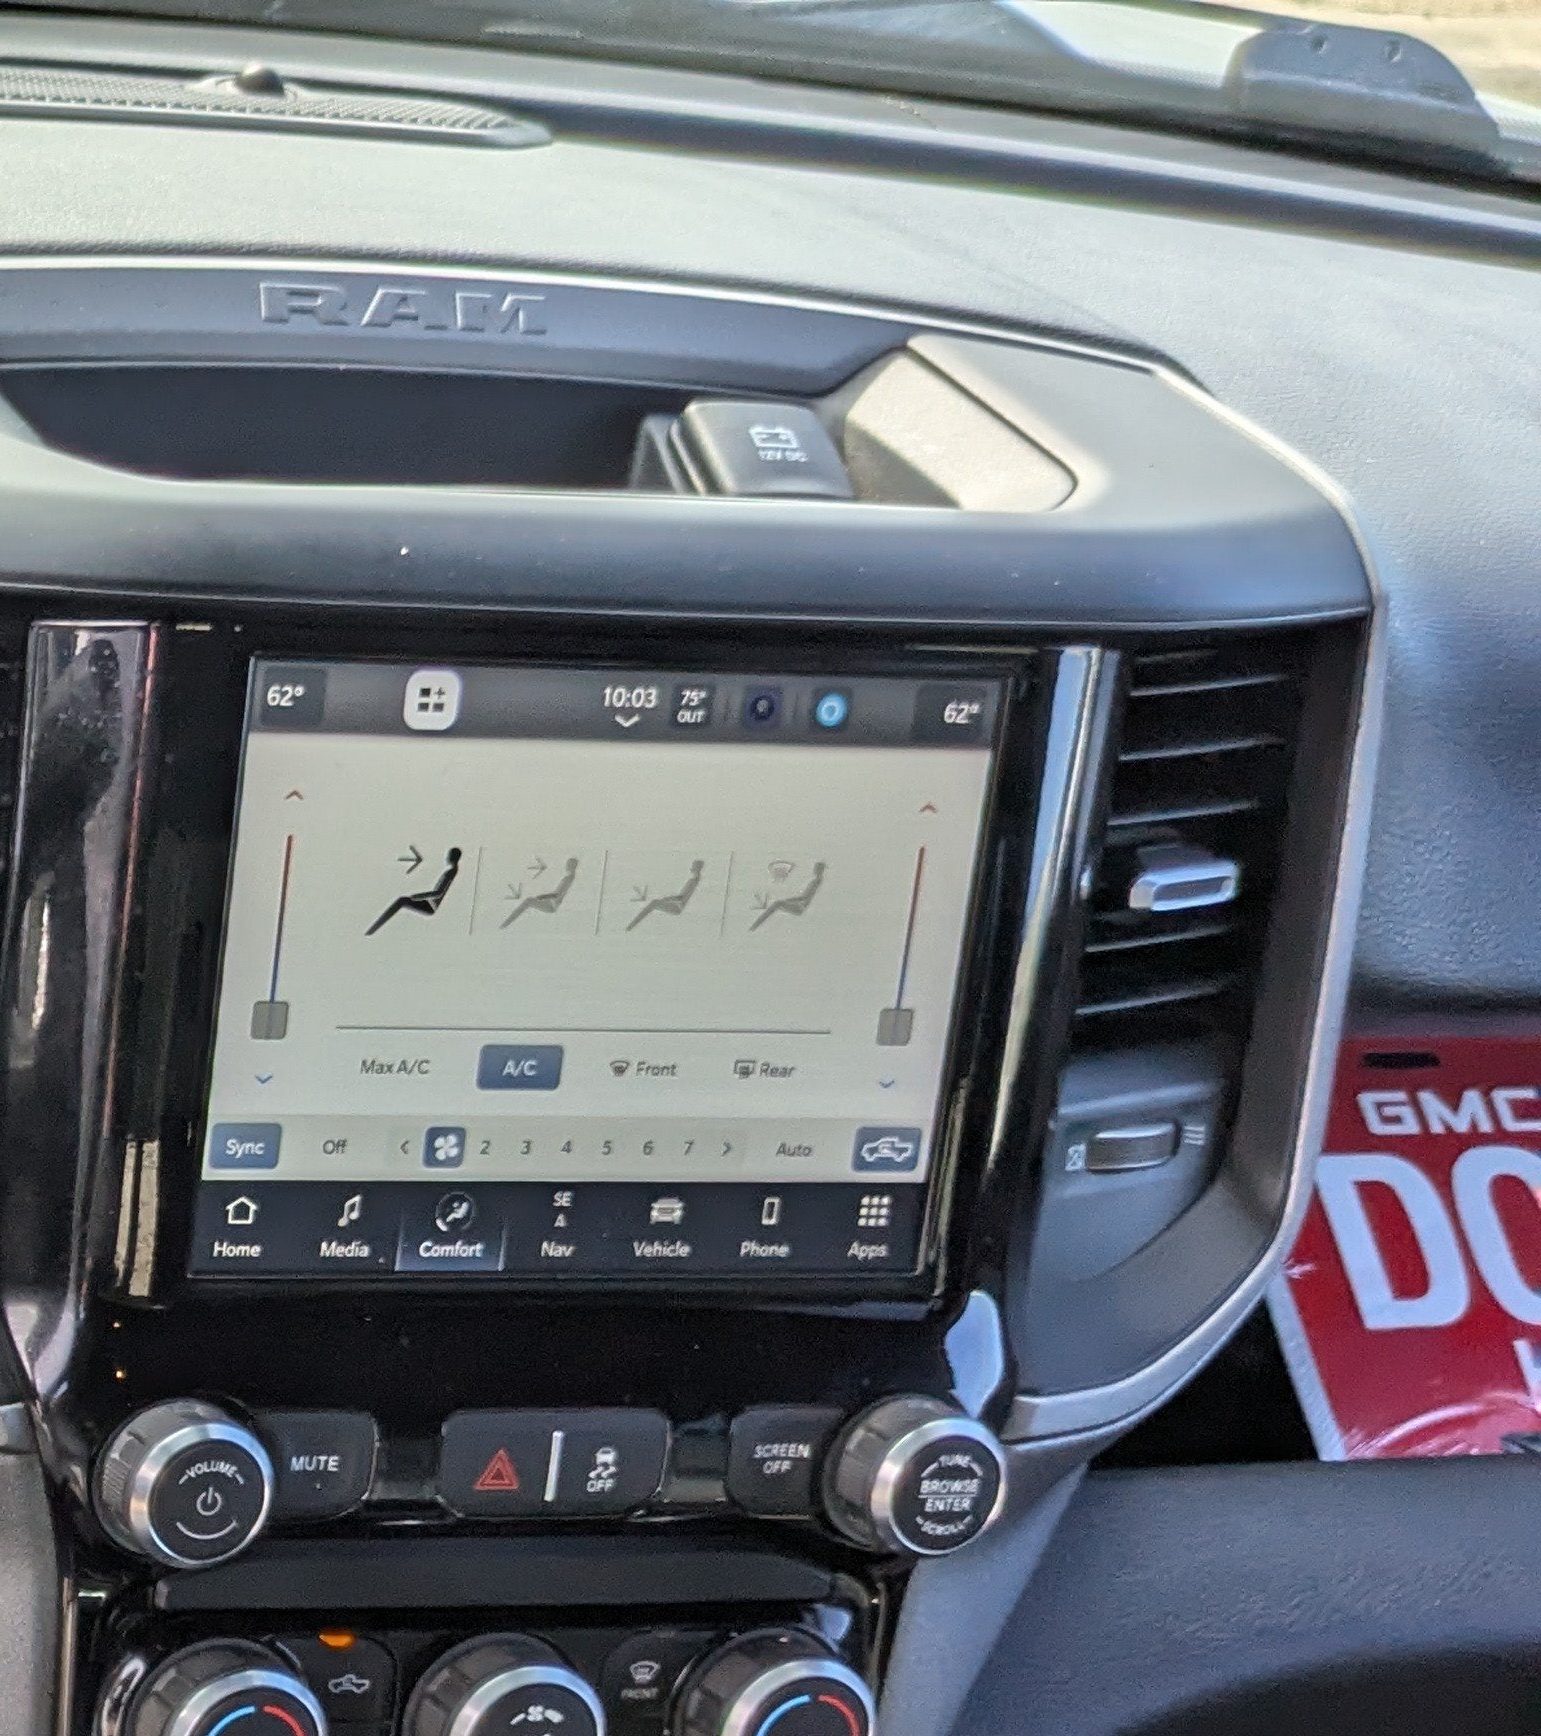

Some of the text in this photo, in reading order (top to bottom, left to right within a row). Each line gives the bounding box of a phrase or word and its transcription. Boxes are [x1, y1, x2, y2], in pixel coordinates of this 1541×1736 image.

[258, 281, 548, 335] RAM
[603, 686, 658, 709] 10:03
[676, 709, 706, 724] OUT
[360, 1059, 431, 1075] Max A/C
[502, 1059, 538, 1077] A/C
[636, 1061, 678, 1078] Front
[760, 1062, 796, 1078] Rear
[1357, 1086, 1541, 1136] GMC
[225, 1139, 265, 1158] Sync
[322, 1139, 348, 1155] Off
[479, 1140, 695, 1155] 2 3 4 5 6 7
[775, 1142, 813, 1157] Auto
[552, 1191, 573, 1208] SE
[213, 1241, 262, 1258] Home
[319, 1241, 370, 1258] Media
[419, 1240, 484, 1258] Comfort
[540, 1241, 574, 1257] Nav
[633, 1241, 692, 1258] Vehicle
[739, 1240, 791, 1258] Phone
[846, 1241, 889, 1261] Apps
[753, 1443, 812, 1458] SCREEN
[186, 1461, 238, 1478] VOLUME
[290, 1454, 340, 1472] MUTE
[762, 1460, 793, 1474] OFF
[586, 1478, 615, 1493] OFF
[920, 1479, 981, 1494] BROWSE
[924, 1498, 973, 1512] ENTER
